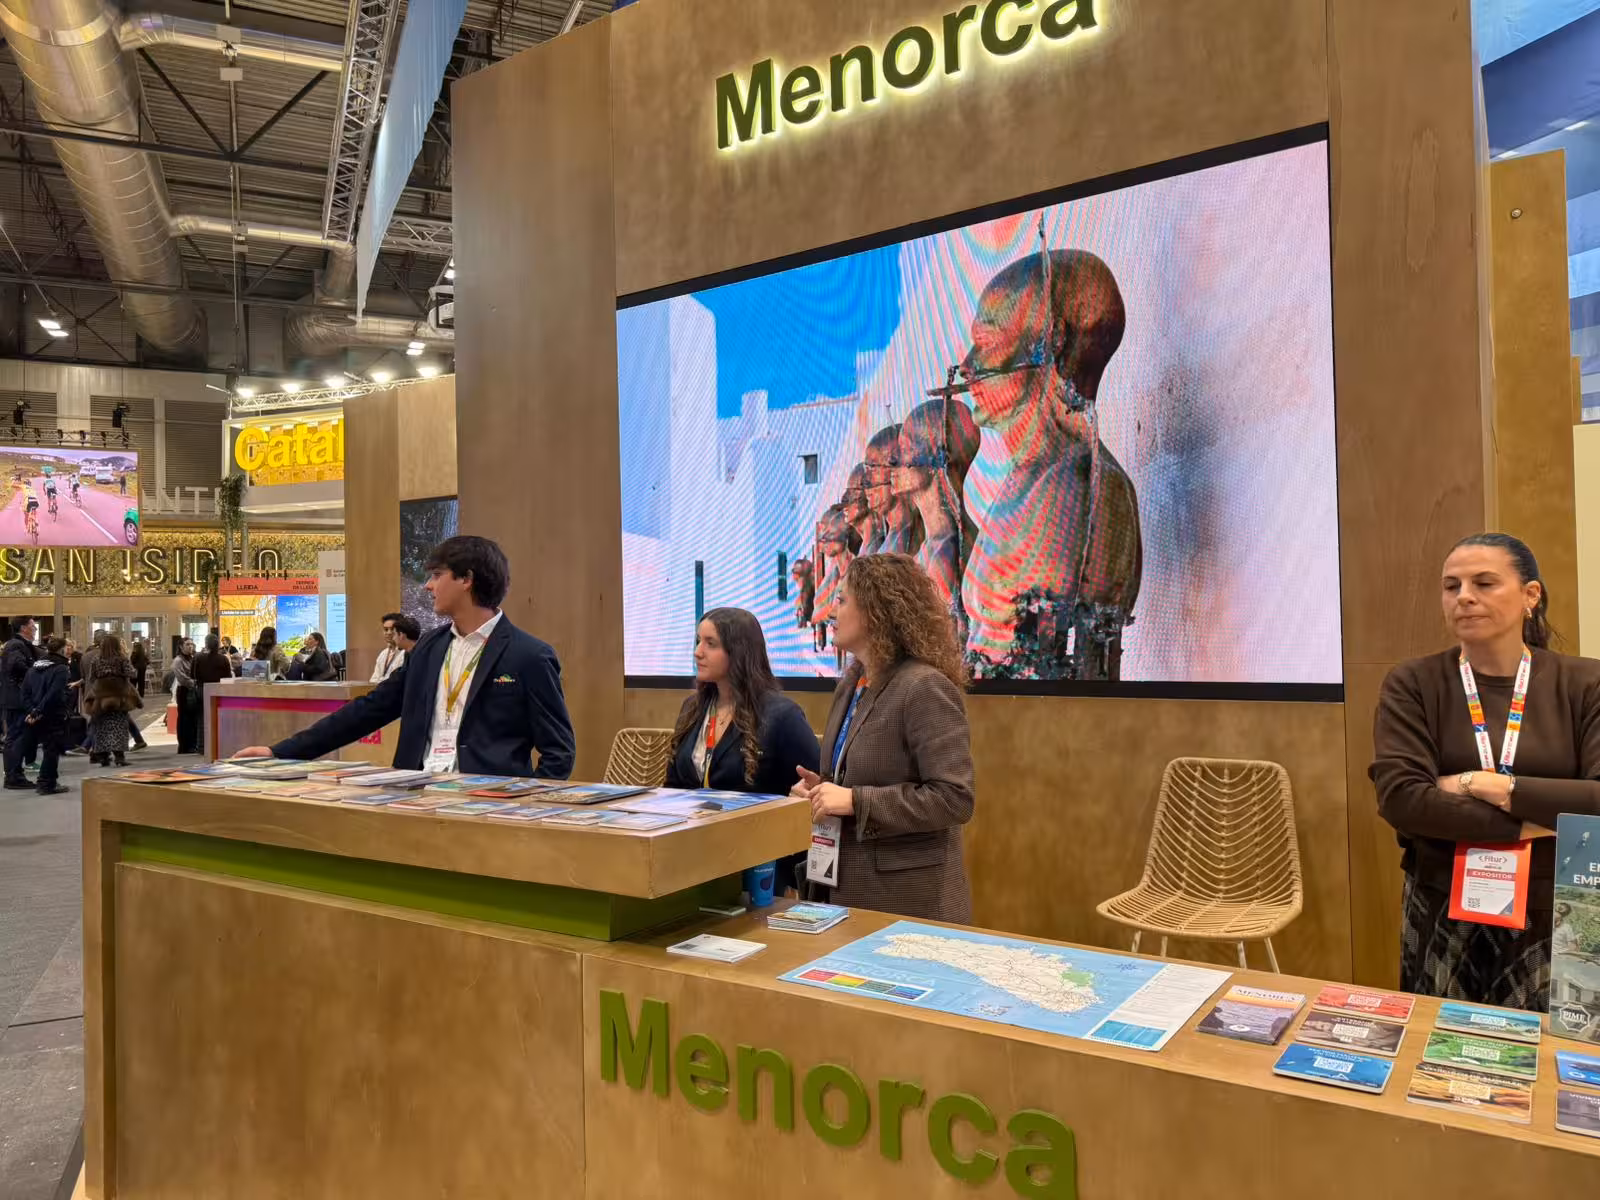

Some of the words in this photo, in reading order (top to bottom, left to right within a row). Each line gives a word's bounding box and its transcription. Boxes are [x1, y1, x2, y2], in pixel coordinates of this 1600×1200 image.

[716, 0, 1097, 149] Menorca
[0, 547, 97, 584] SAN
[1472, 871, 1513, 879] EXPOSITOR
[1484, 855, 1503, 863] Fitur
[599, 988, 1077, 1200] Menorca
